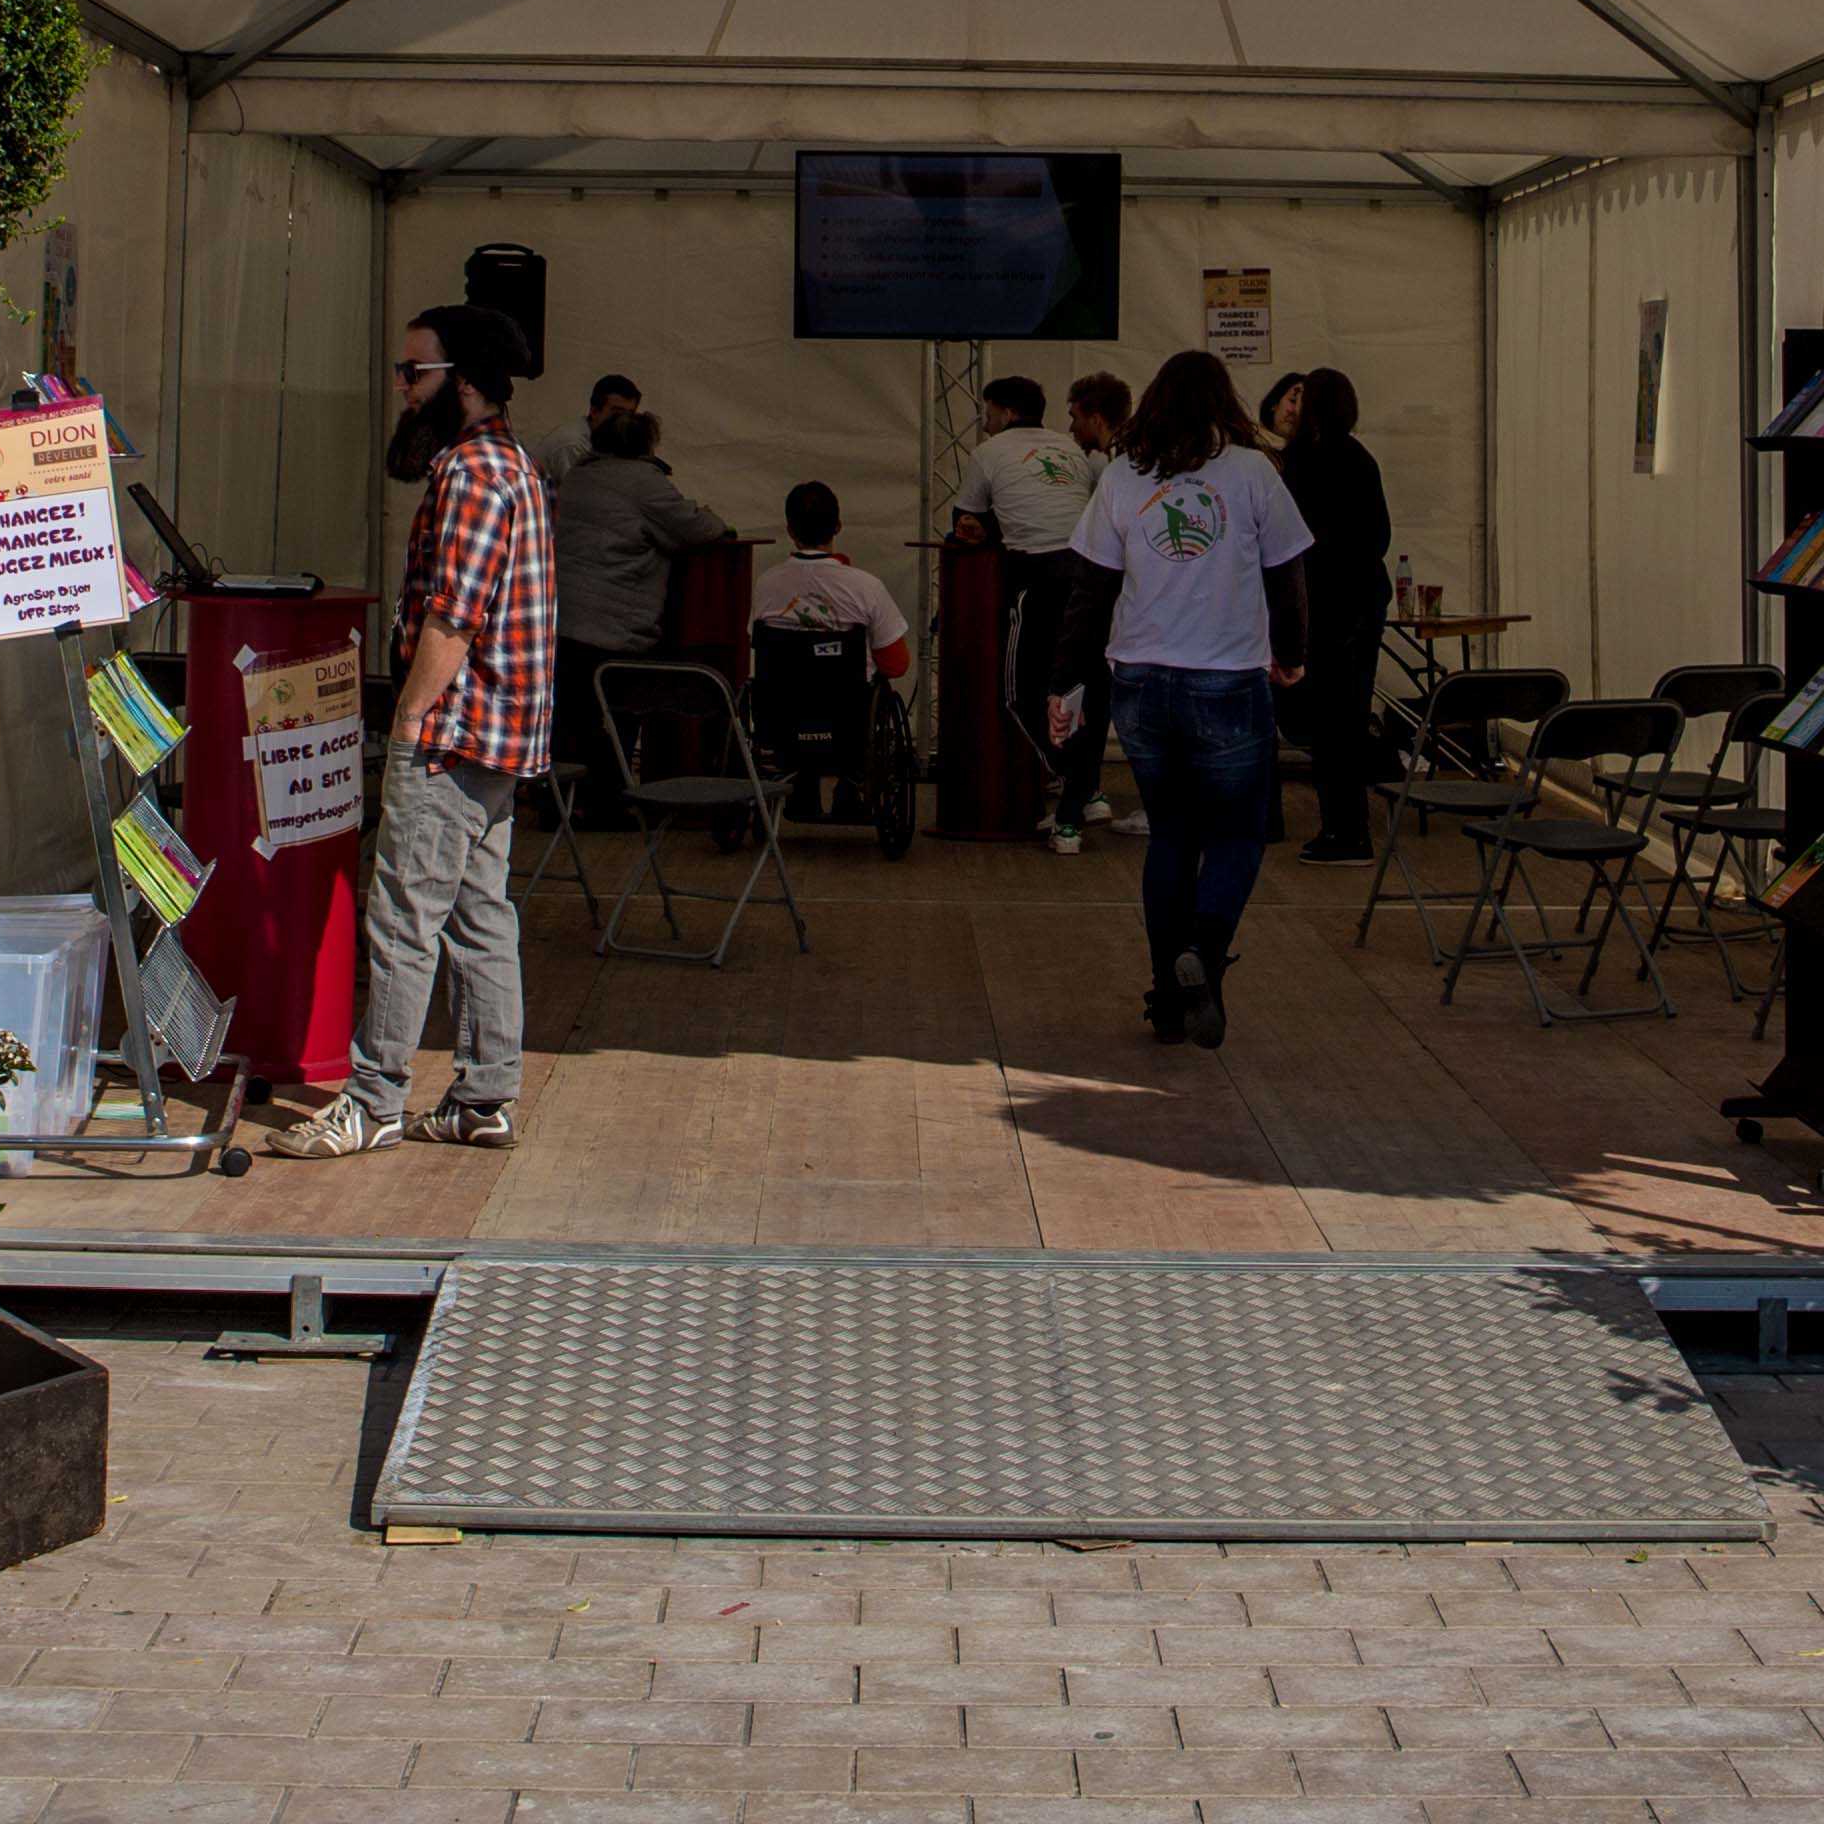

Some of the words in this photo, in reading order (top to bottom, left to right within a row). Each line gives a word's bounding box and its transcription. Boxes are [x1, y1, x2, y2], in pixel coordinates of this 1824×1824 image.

[30, 424, 96, 447] DIJON
[3, 589, 56, 606] AgroSup
[58, 583, 91, 598] Dijon
[18, 607, 45, 621] UFR
[316, 659, 355, 681] DIJON
[261, 744, 314, 766] LIBRE
[289, 777, 312, 795] AU
[322, 766, 352, 788] SITE
